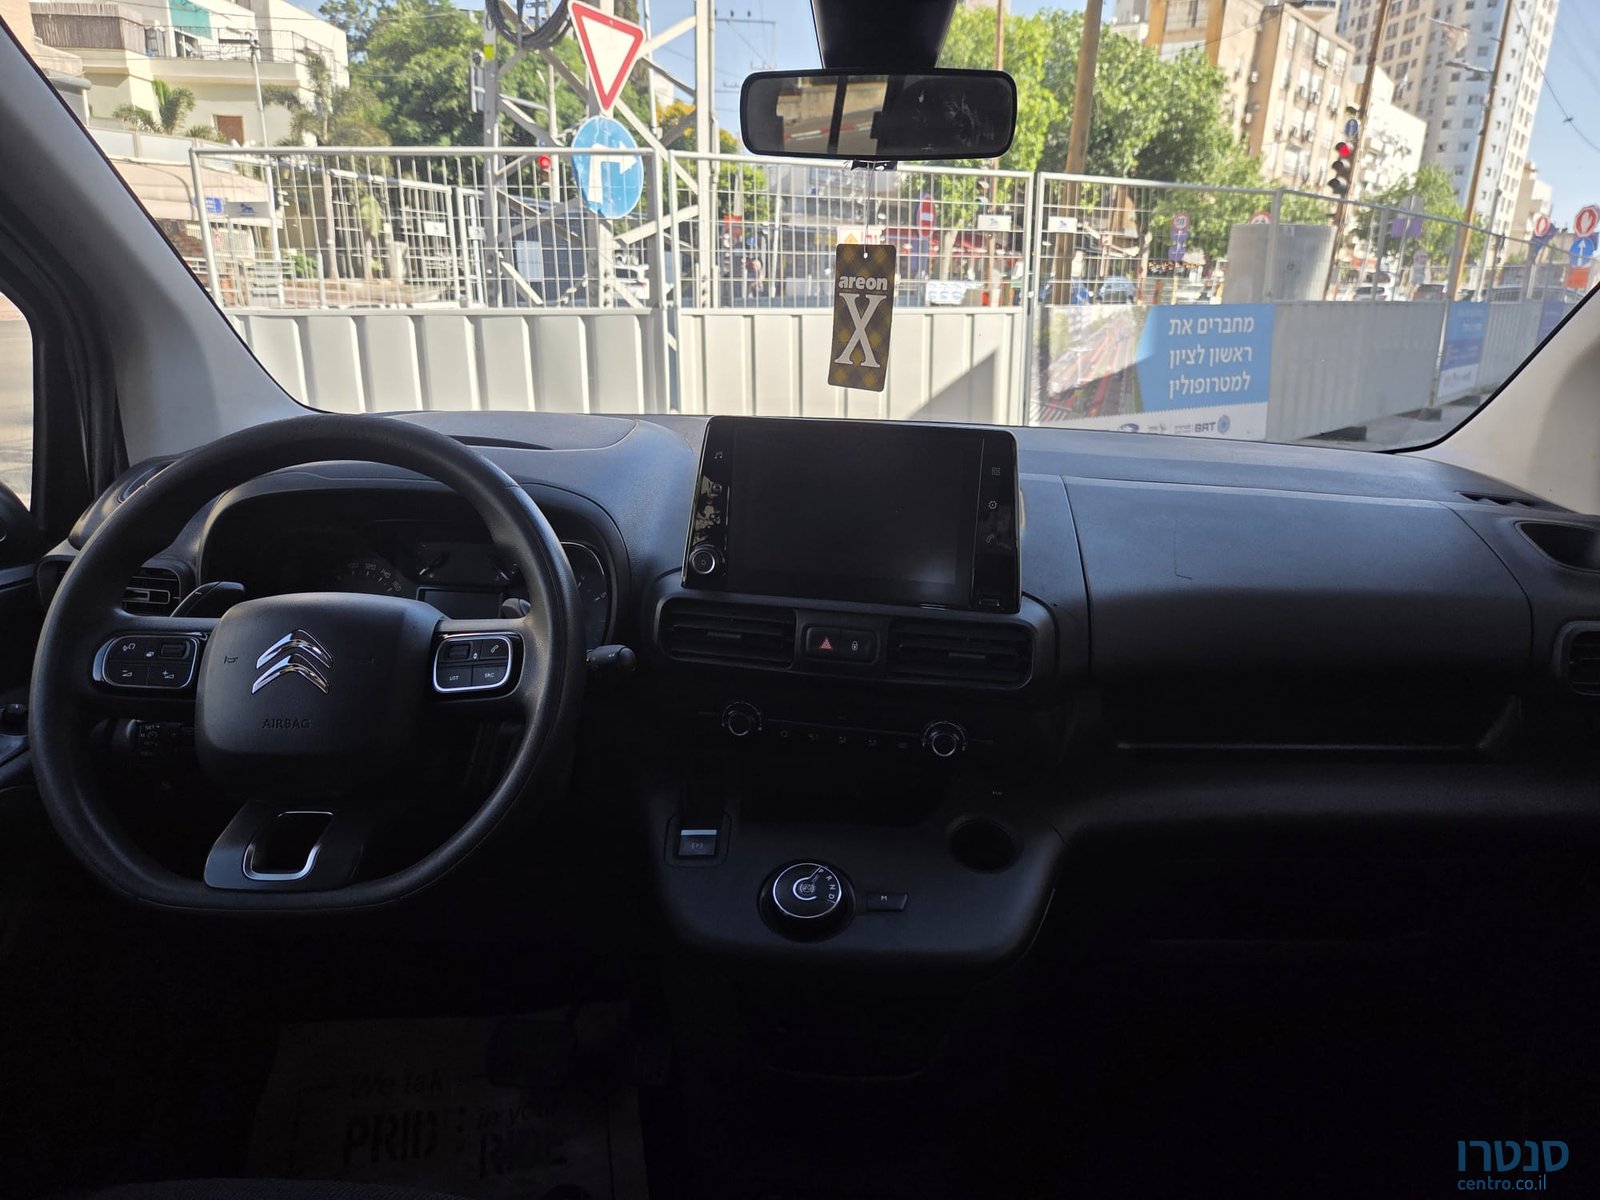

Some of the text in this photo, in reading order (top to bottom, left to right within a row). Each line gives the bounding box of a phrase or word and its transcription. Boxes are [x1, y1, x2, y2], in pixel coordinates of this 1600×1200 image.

[838, 275, 887, 290] areon
[834, 293, 886, 367] X
[1168, 316, 1254, 336] מחברים את
[1169, 343, 1252, 369] ראשון לציון
[1169, 371, 1251, 400] למטרופולין
[262, 718, 310, 729] AIRBAG
